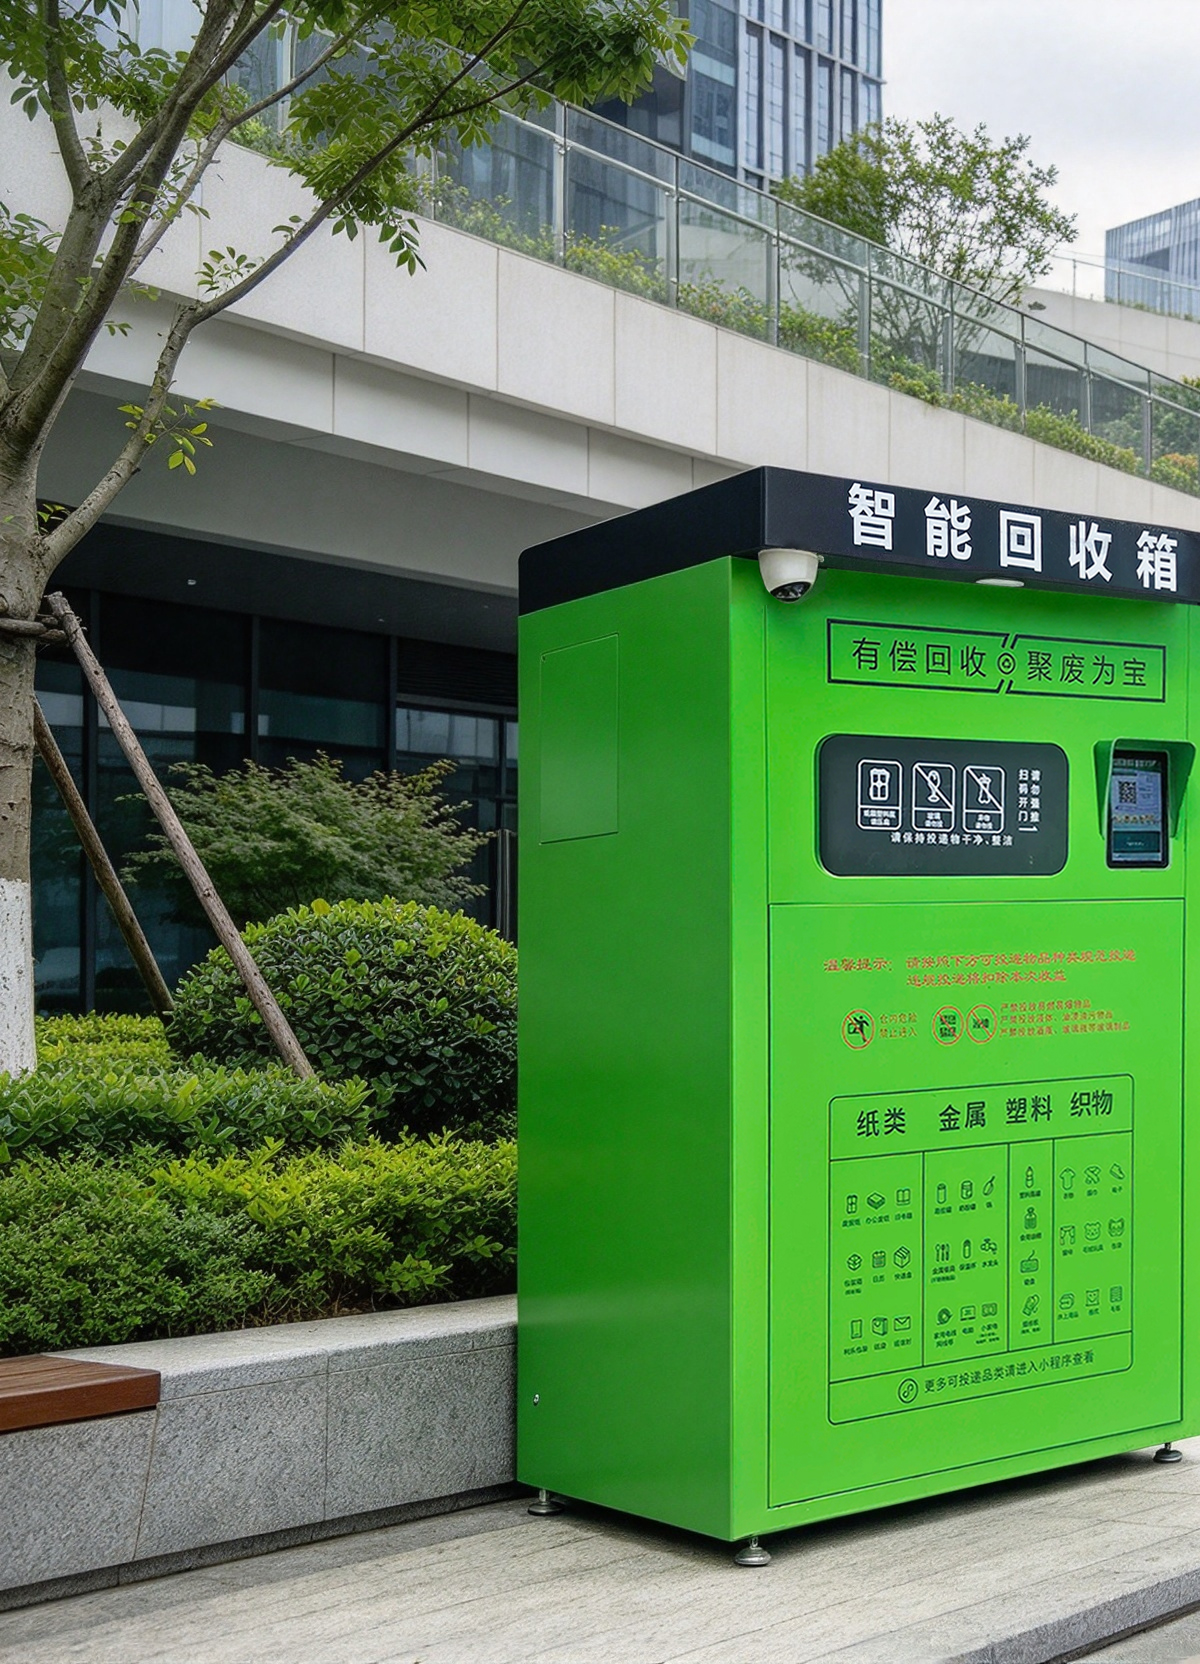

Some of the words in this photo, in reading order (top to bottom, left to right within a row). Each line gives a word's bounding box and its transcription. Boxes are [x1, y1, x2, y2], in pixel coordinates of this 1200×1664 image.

[848, 483, 1179, 592] 智能回收箱
[852, 637, 987, 680] 有偿回收
[1026, 651, 1148, 688] 聚废为宝
[1018, 769, 1028, 821] 扫码开门
[857, 1108, 905, 1137] 纸类
[939, 1101, 985, 1131] 金属
[1006, 1095, 1052, 1124] 塑料
[1071, 1090, 1112, 1117] 织物
[924, 1349, 1095, 1394] 更多可投递品类请进入小程序查看
